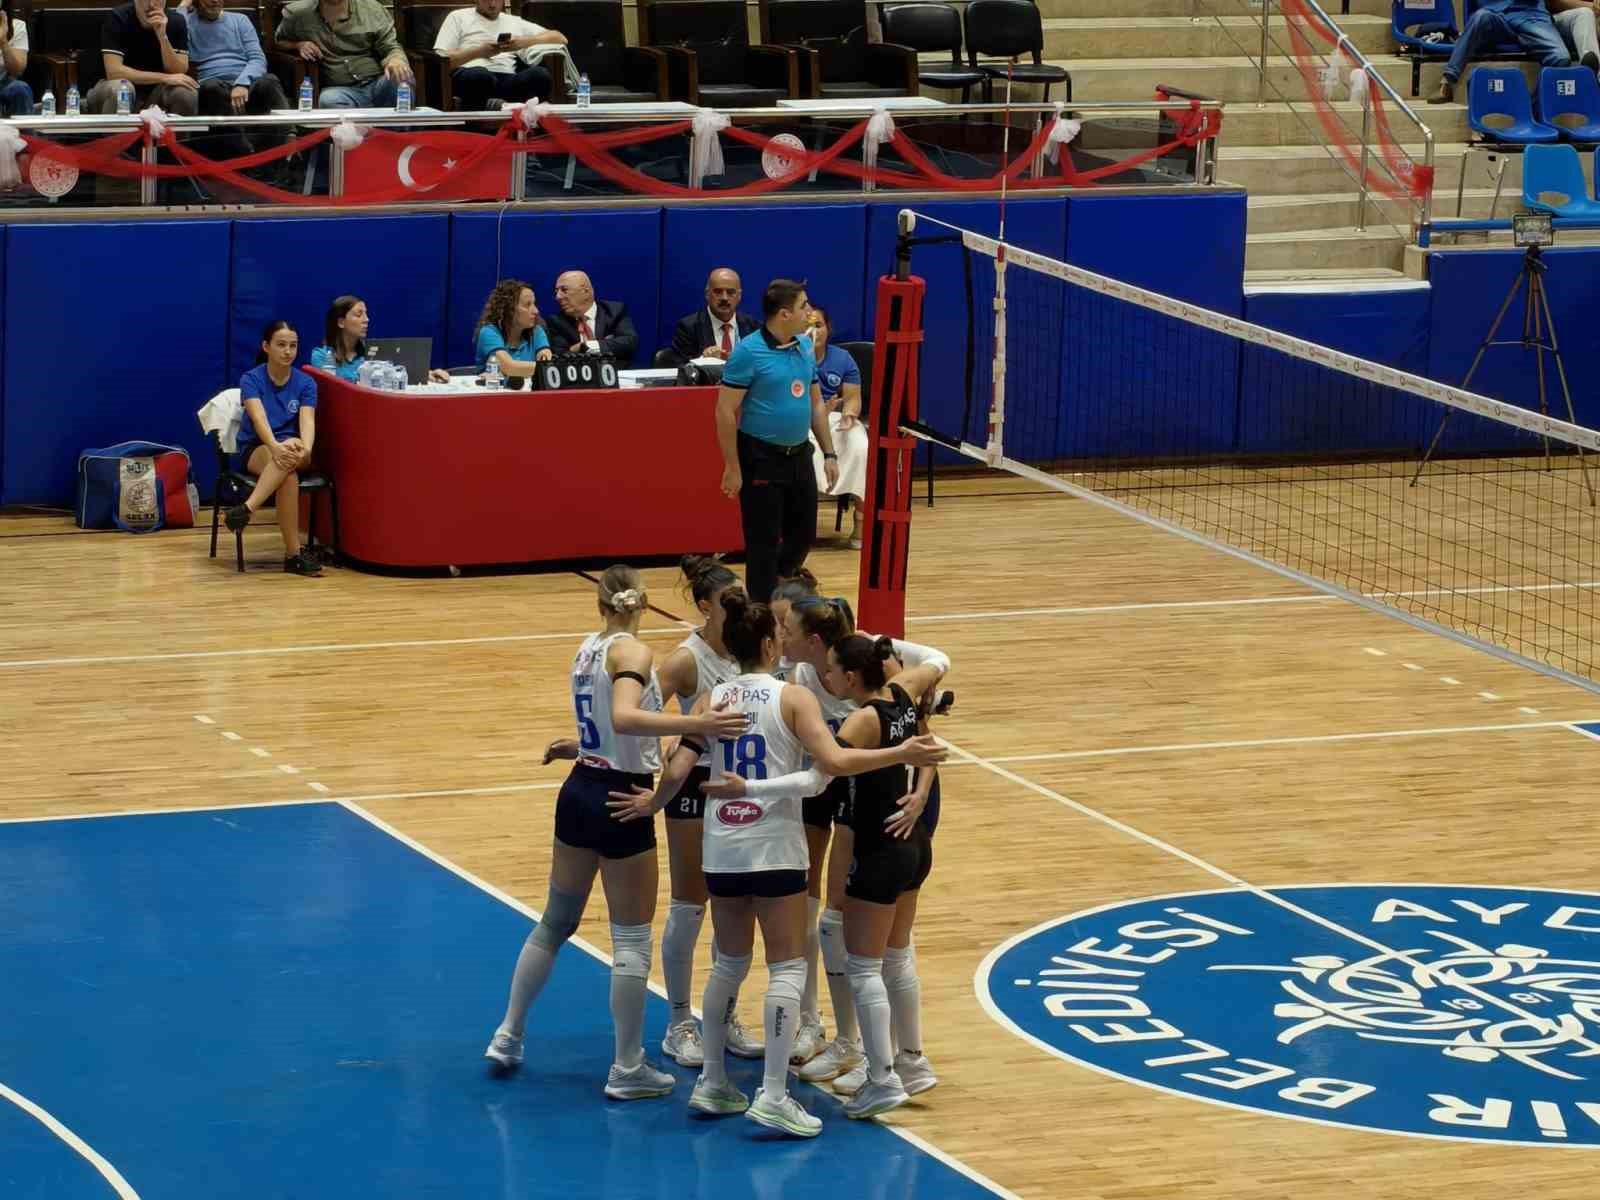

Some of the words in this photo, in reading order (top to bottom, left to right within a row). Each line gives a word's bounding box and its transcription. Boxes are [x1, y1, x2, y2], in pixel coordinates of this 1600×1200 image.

[546, 366, 560, 388] 0
[601, 363, 616, 386] 0
[575, 694, 600, 749] 5
[718, 734, 768, 780] 18
[680, 797, 698, 814] 21
